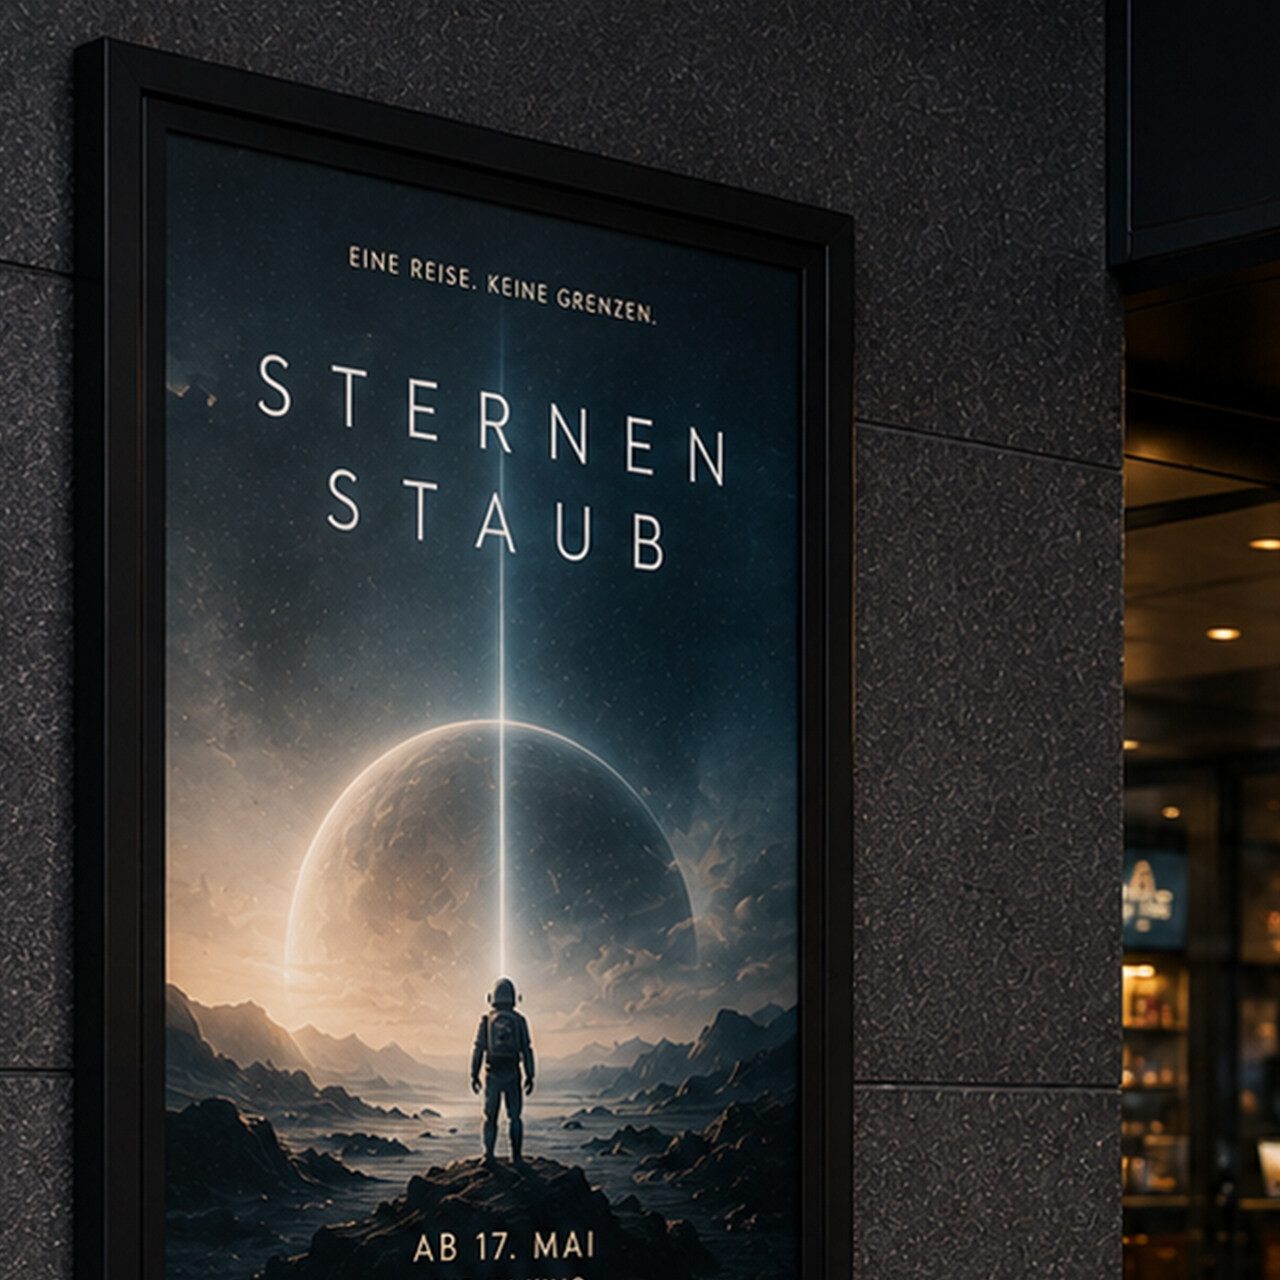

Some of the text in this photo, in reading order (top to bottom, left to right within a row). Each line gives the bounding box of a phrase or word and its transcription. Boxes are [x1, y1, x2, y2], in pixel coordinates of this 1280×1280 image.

[348, 245, 658, 325] EINE REISE. KEINE GRENZEN.
[257, 353, 726, 487] STERNEN
[326, 467, 666, 572] STAUB
[413, 1230, 595, 1262] AB 17. MAI
